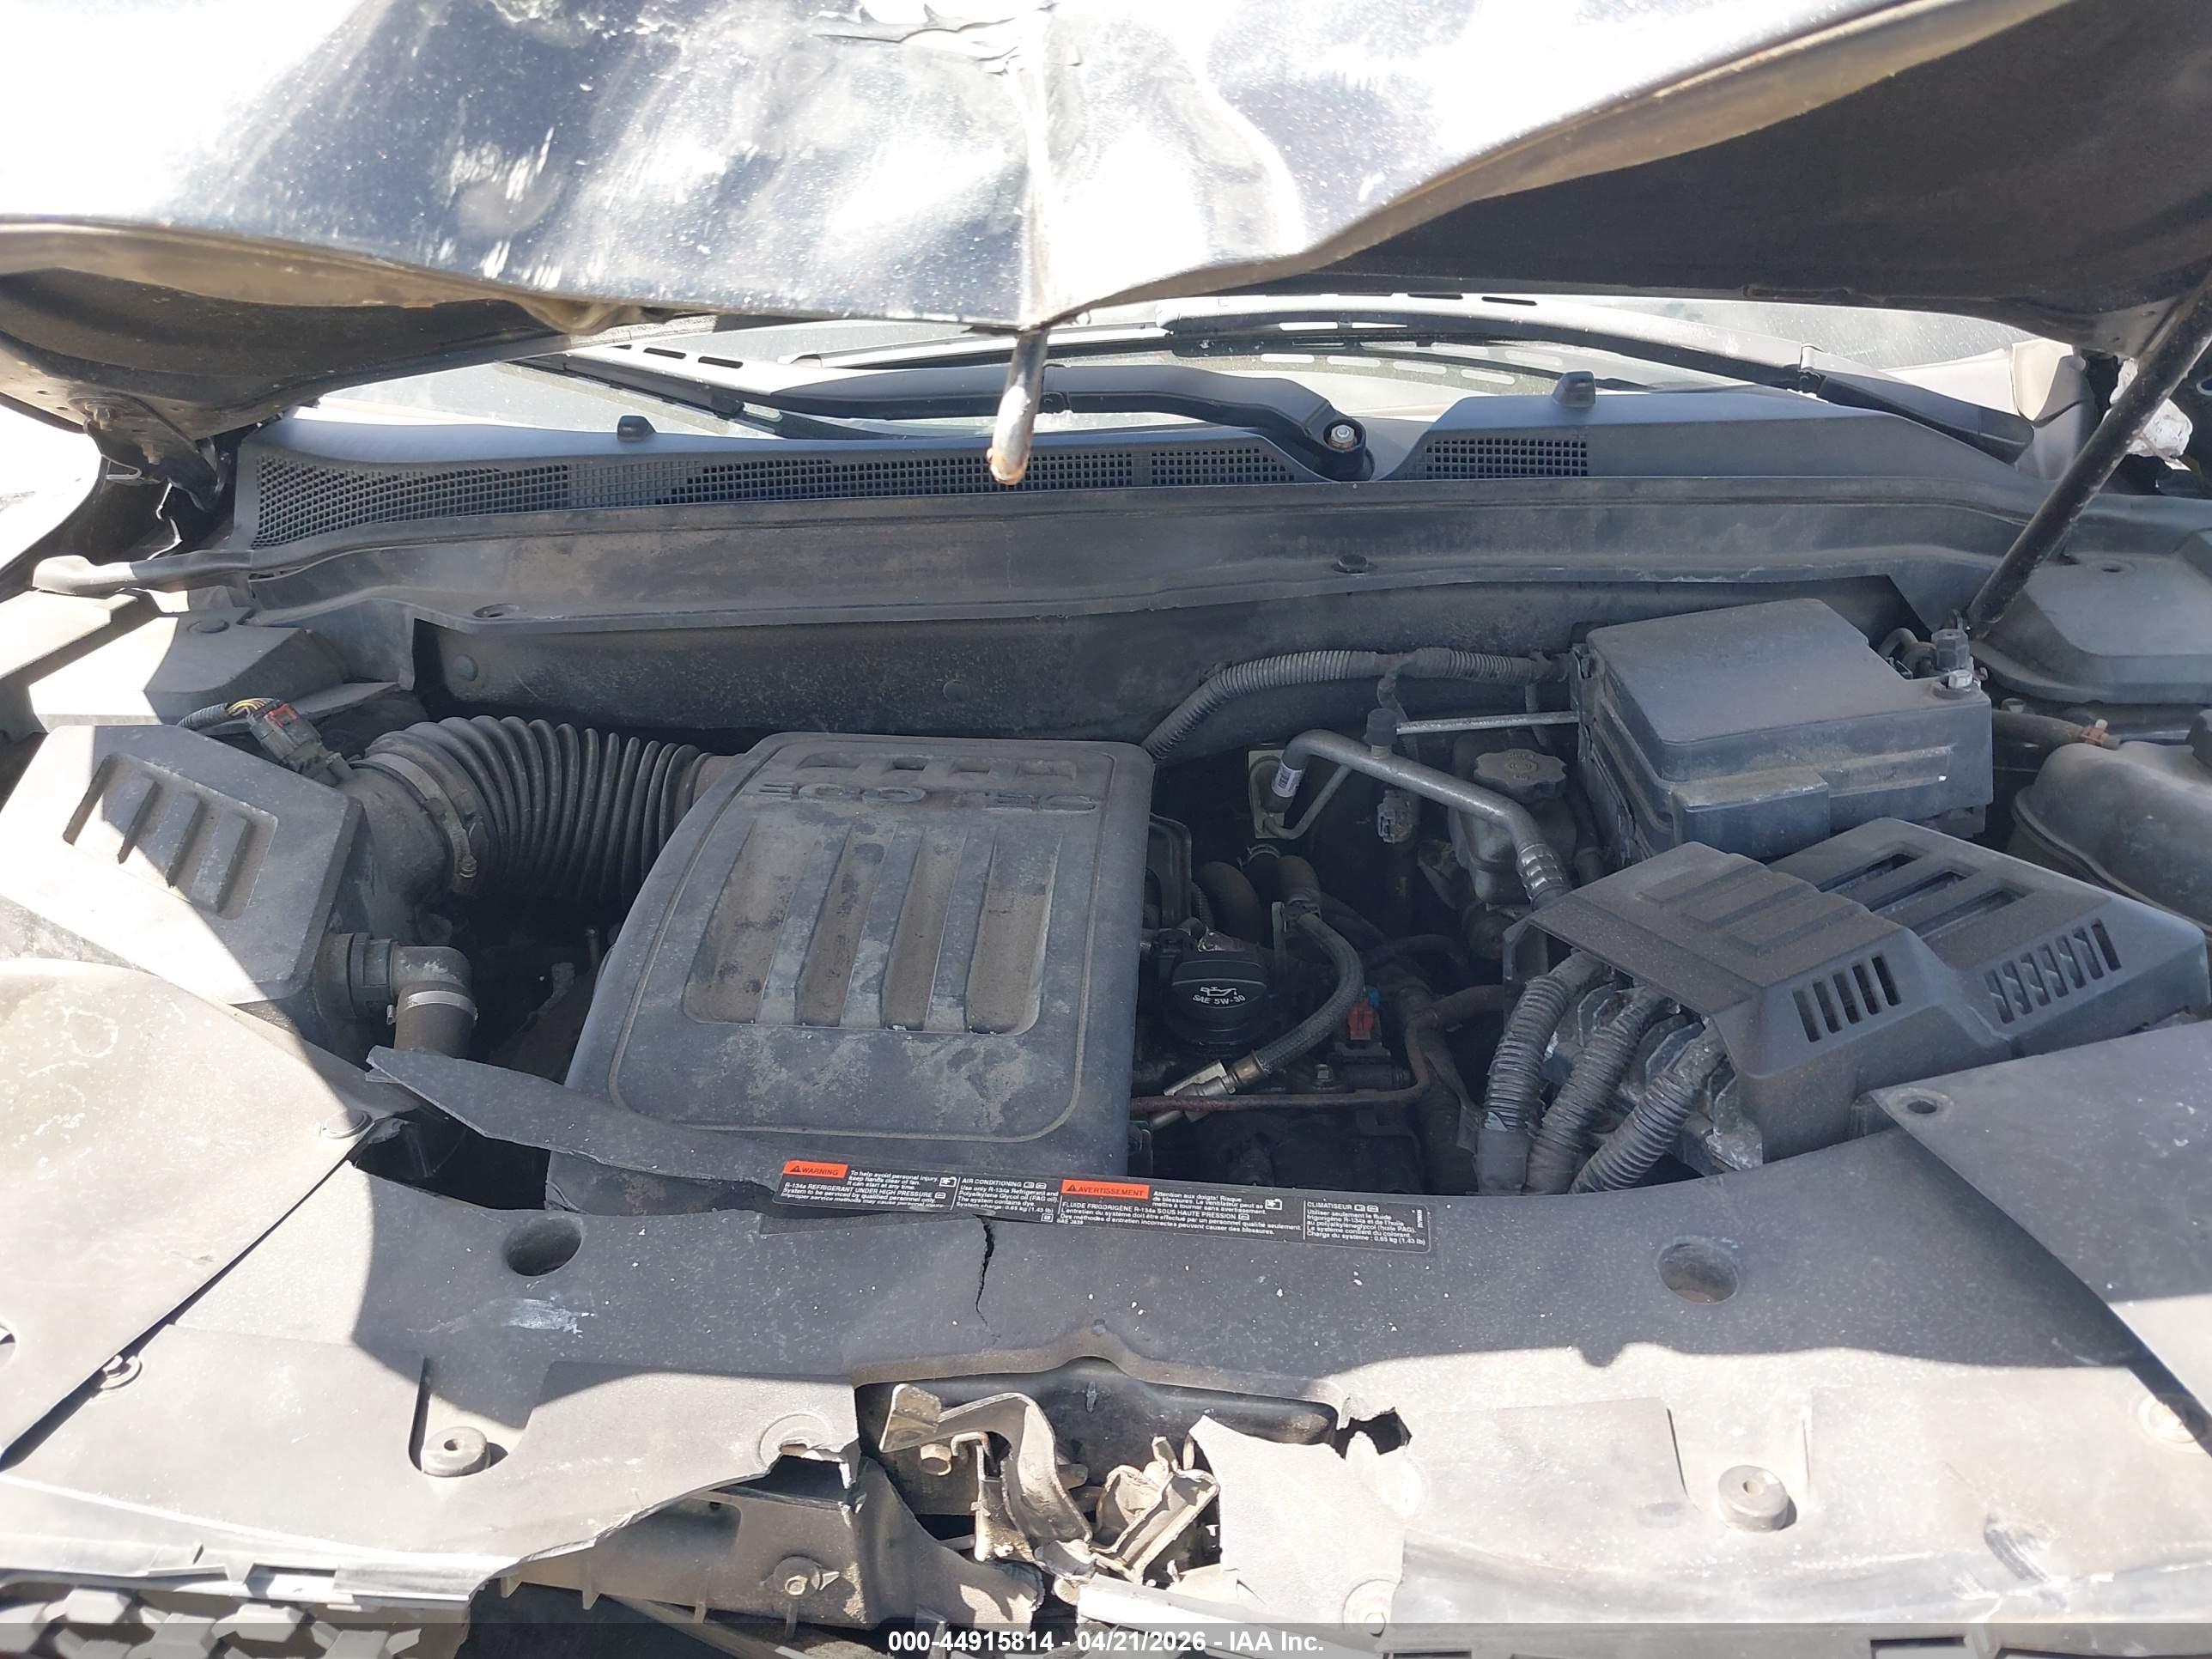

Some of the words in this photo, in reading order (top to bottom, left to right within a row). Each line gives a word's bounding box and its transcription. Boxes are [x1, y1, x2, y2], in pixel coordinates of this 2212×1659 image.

[1192, 995, 1210, 1004] SAE
[1214, 995, 1245, 1004] 5W-30
[975, 1179, 1022, 1187] CONDITIONING
[808, 1184, 854, 1192] REFRIGERANT
[1078, 1186, 1144, 1196] AVERTISSEMENT
